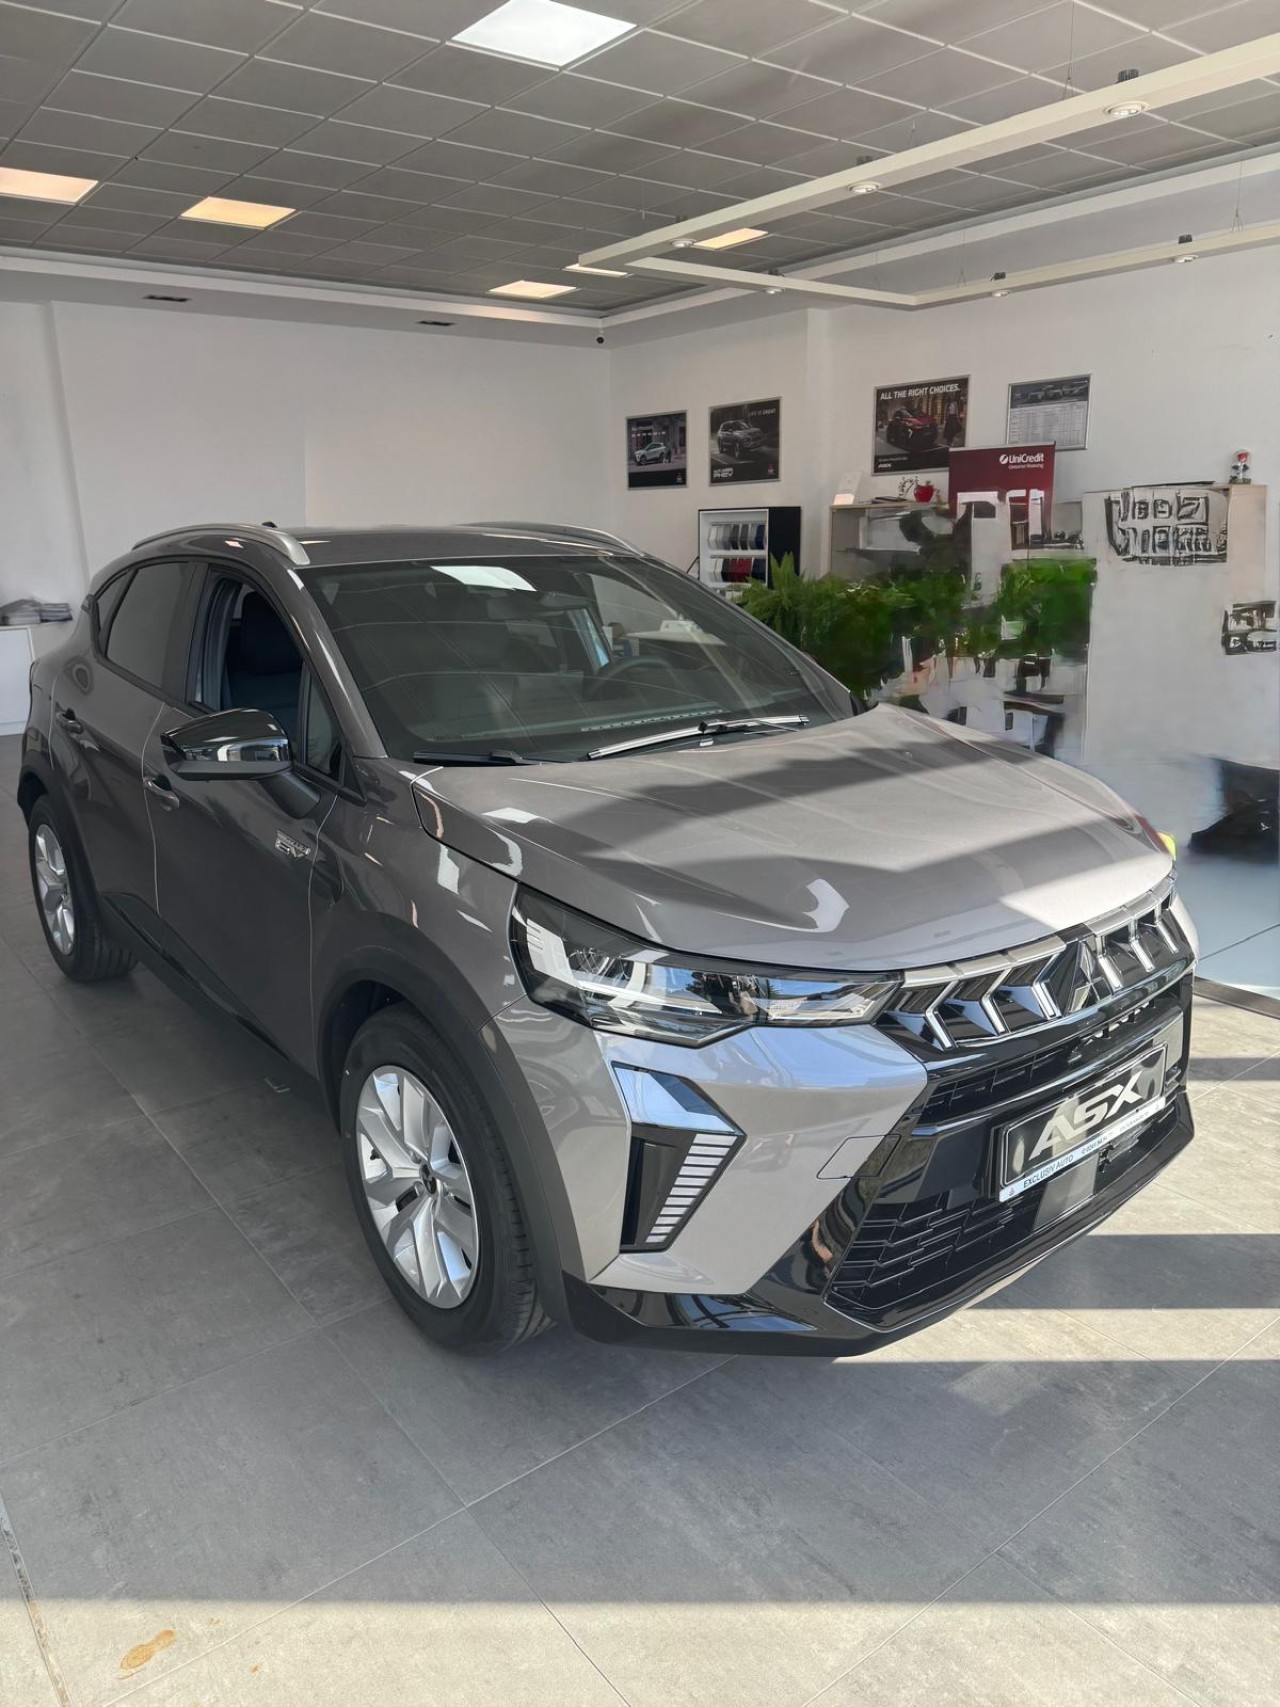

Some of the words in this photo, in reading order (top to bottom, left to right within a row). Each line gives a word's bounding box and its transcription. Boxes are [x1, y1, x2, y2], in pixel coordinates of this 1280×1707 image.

[880, 392, 893, 400] ALL
[894, 389, 907, 398] THE
[908, 387, 928, 397] RIGHT
[929, 383, 961, 394] CHOICES.
[1009, 452, 1044, 464] UniCredit
[1029, 1070, 1143, 1161] ASX
[1023, 1162, 1056, 1188] EXCLUSIV
[1055, 1154, 1074, 1171] AUTO
